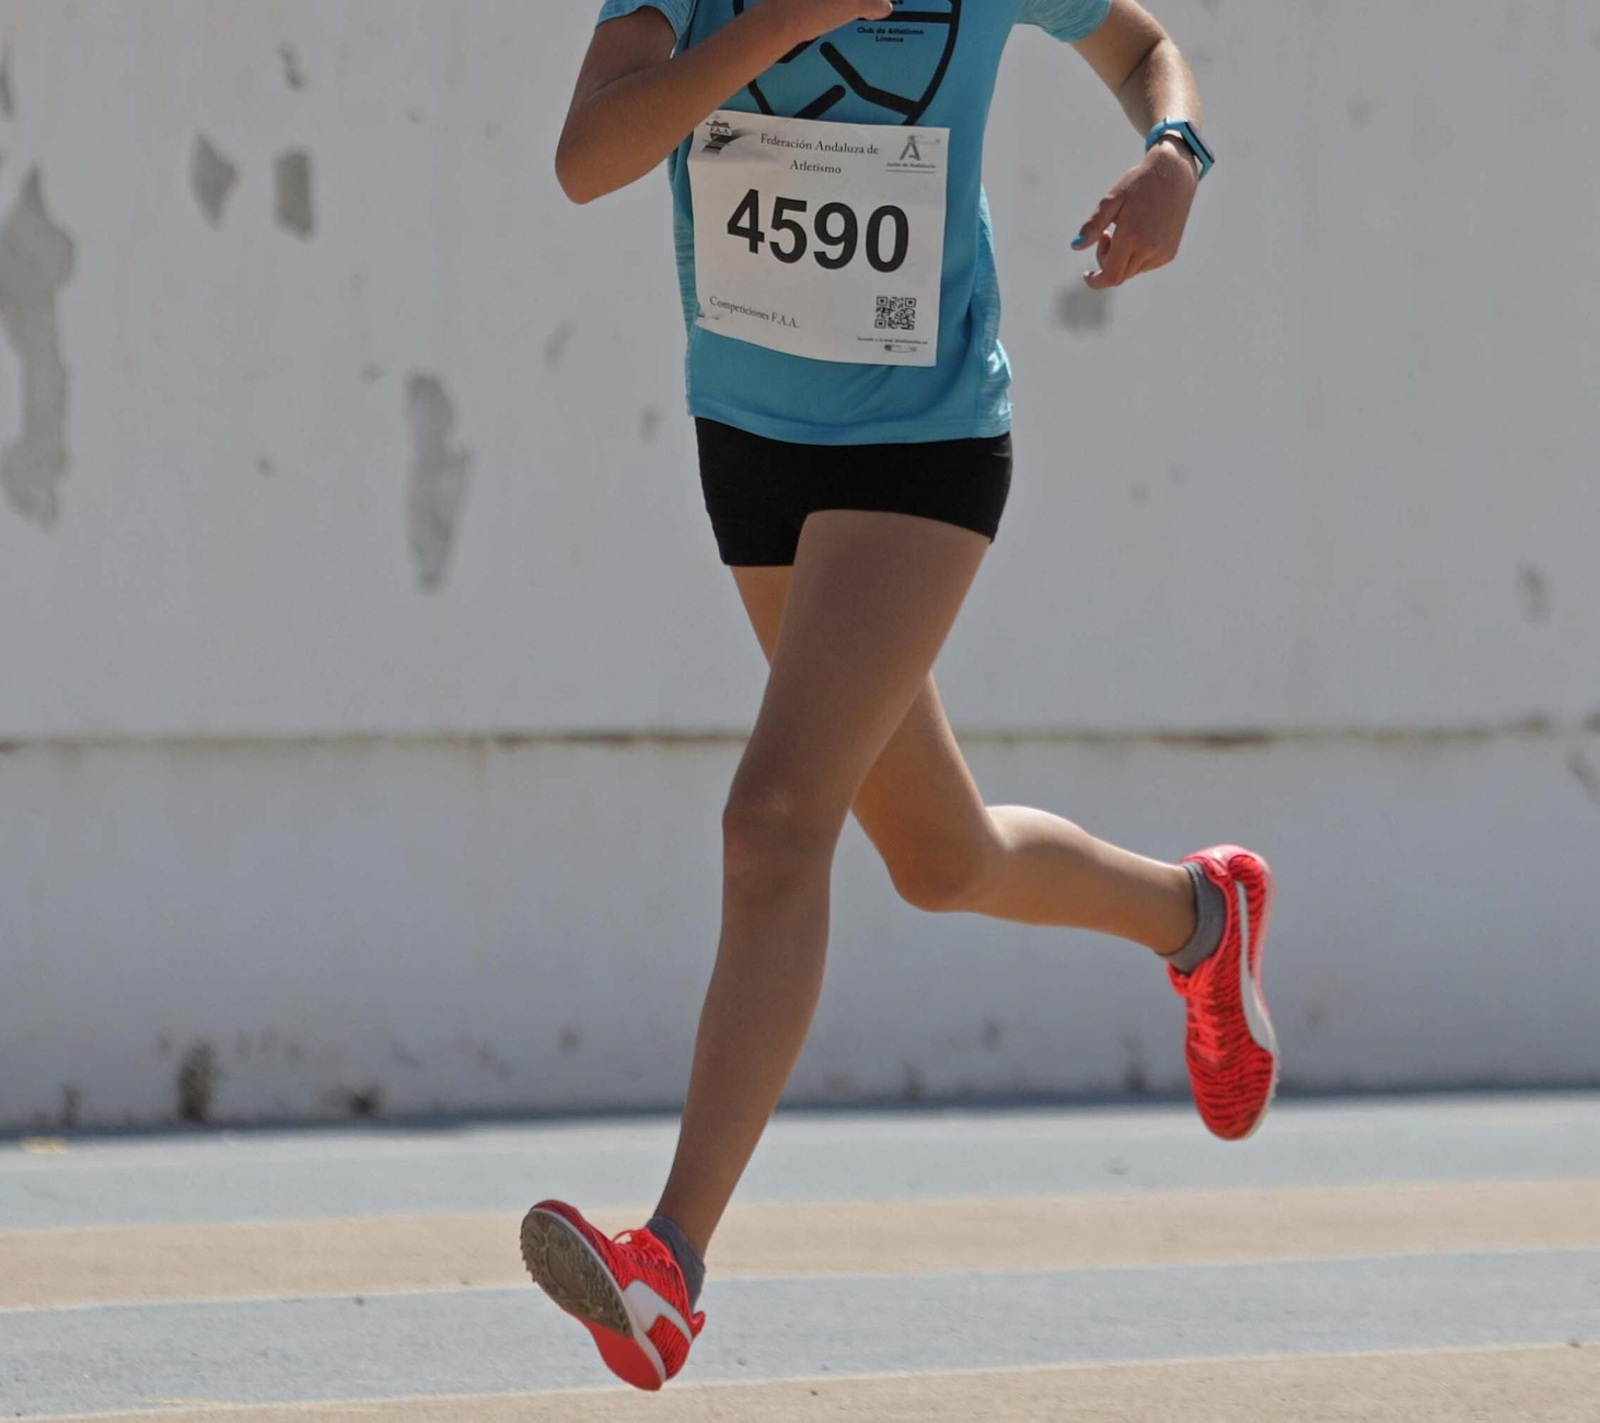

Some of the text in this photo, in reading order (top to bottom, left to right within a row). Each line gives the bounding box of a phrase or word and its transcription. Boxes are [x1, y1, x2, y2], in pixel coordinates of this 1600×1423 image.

[857, 26, 874, 34] Club
[888, 28, 924, 36] Atletismo
[760, 133, 879, 155] Federación Andaluza de
[789, 159, 842, 175] Atletismo
[727, 188, 909, 273] 4590
[709, 295, 800, 329] Competiciones F.A.A.
